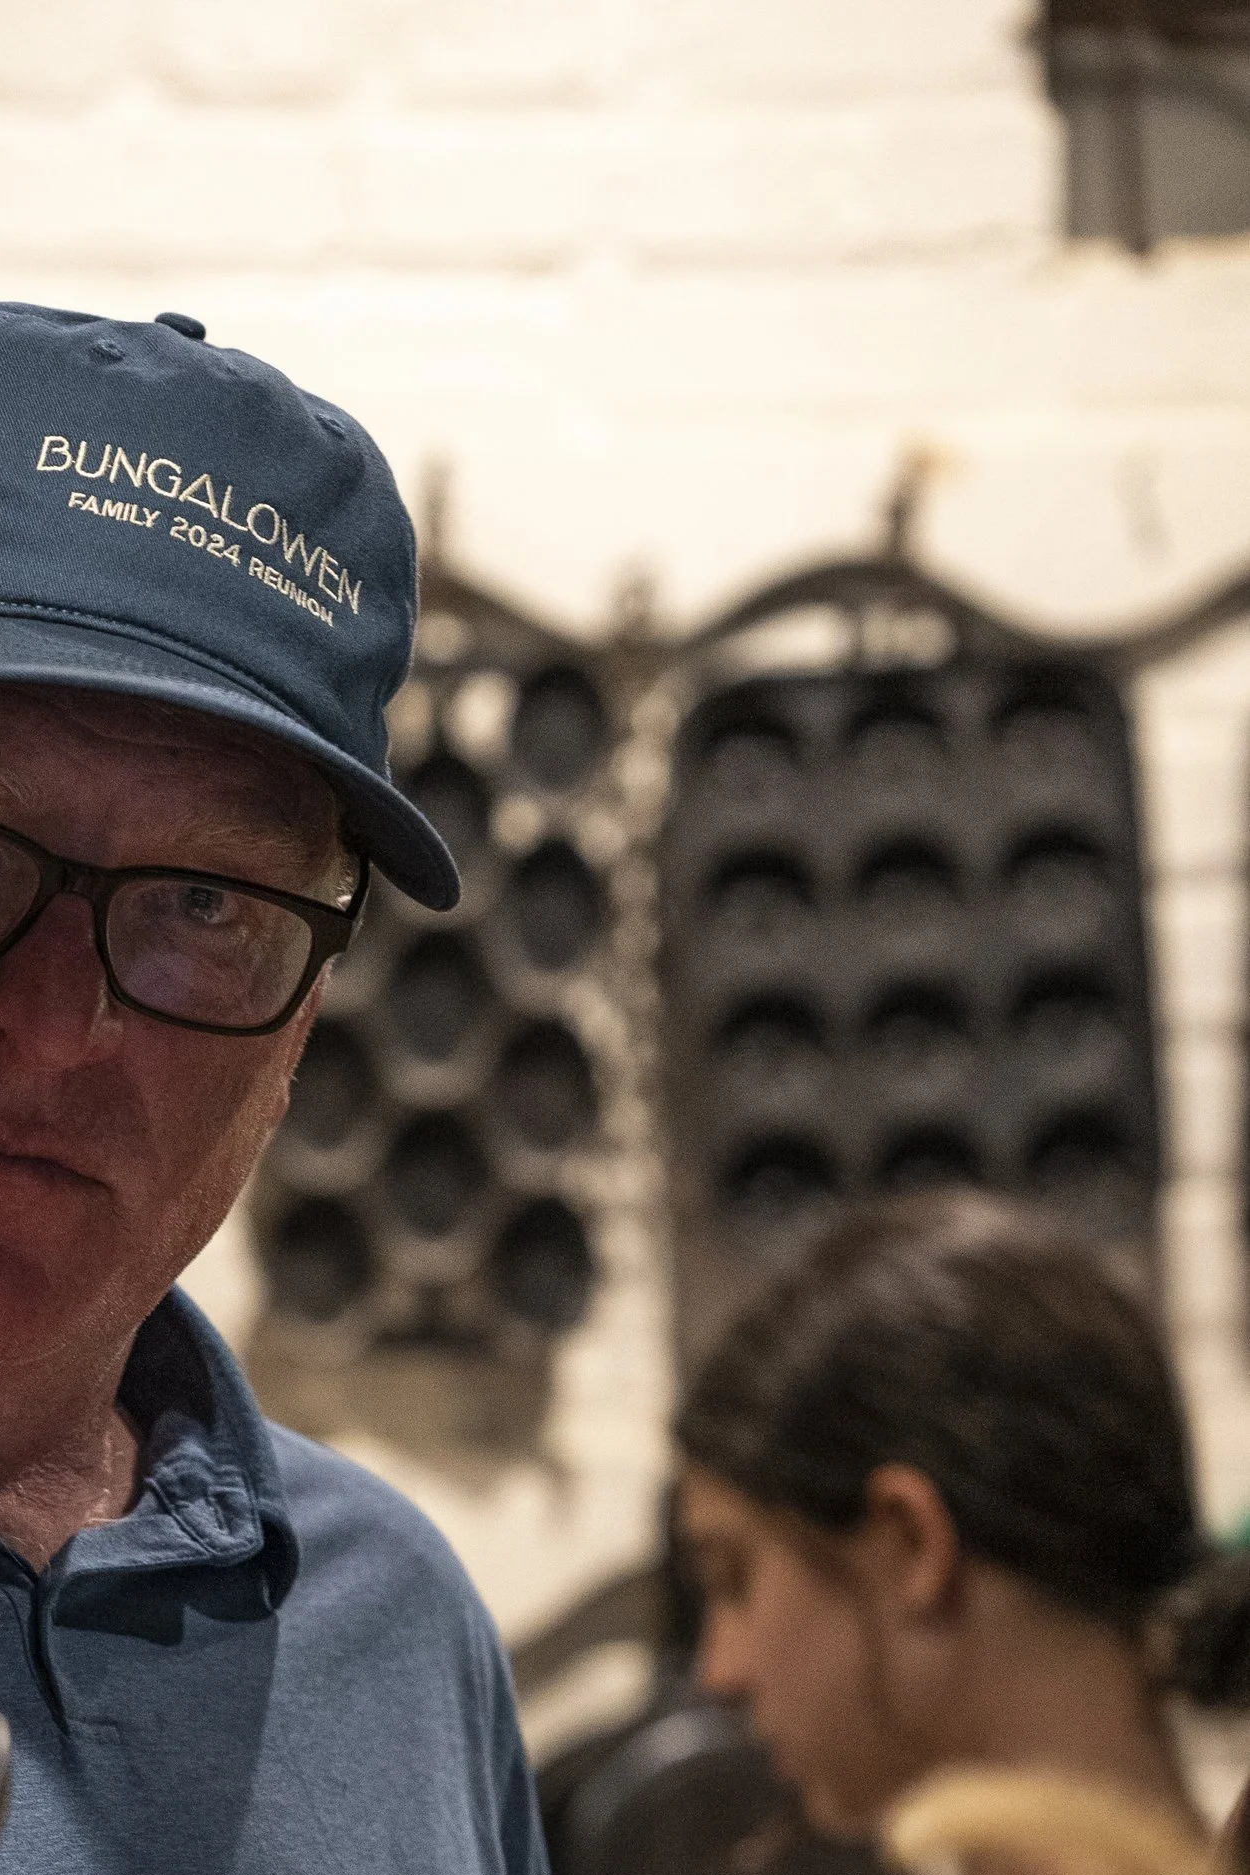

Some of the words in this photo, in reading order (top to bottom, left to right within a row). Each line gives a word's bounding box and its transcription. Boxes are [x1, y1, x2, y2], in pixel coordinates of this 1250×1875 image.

[36, 435, 363, 615] BUNGALOWEN
[68, 491, 162, 528] FAMILY
[169, 516, 242, 567] 2024
[248, 556, 334, 628] REUNION
